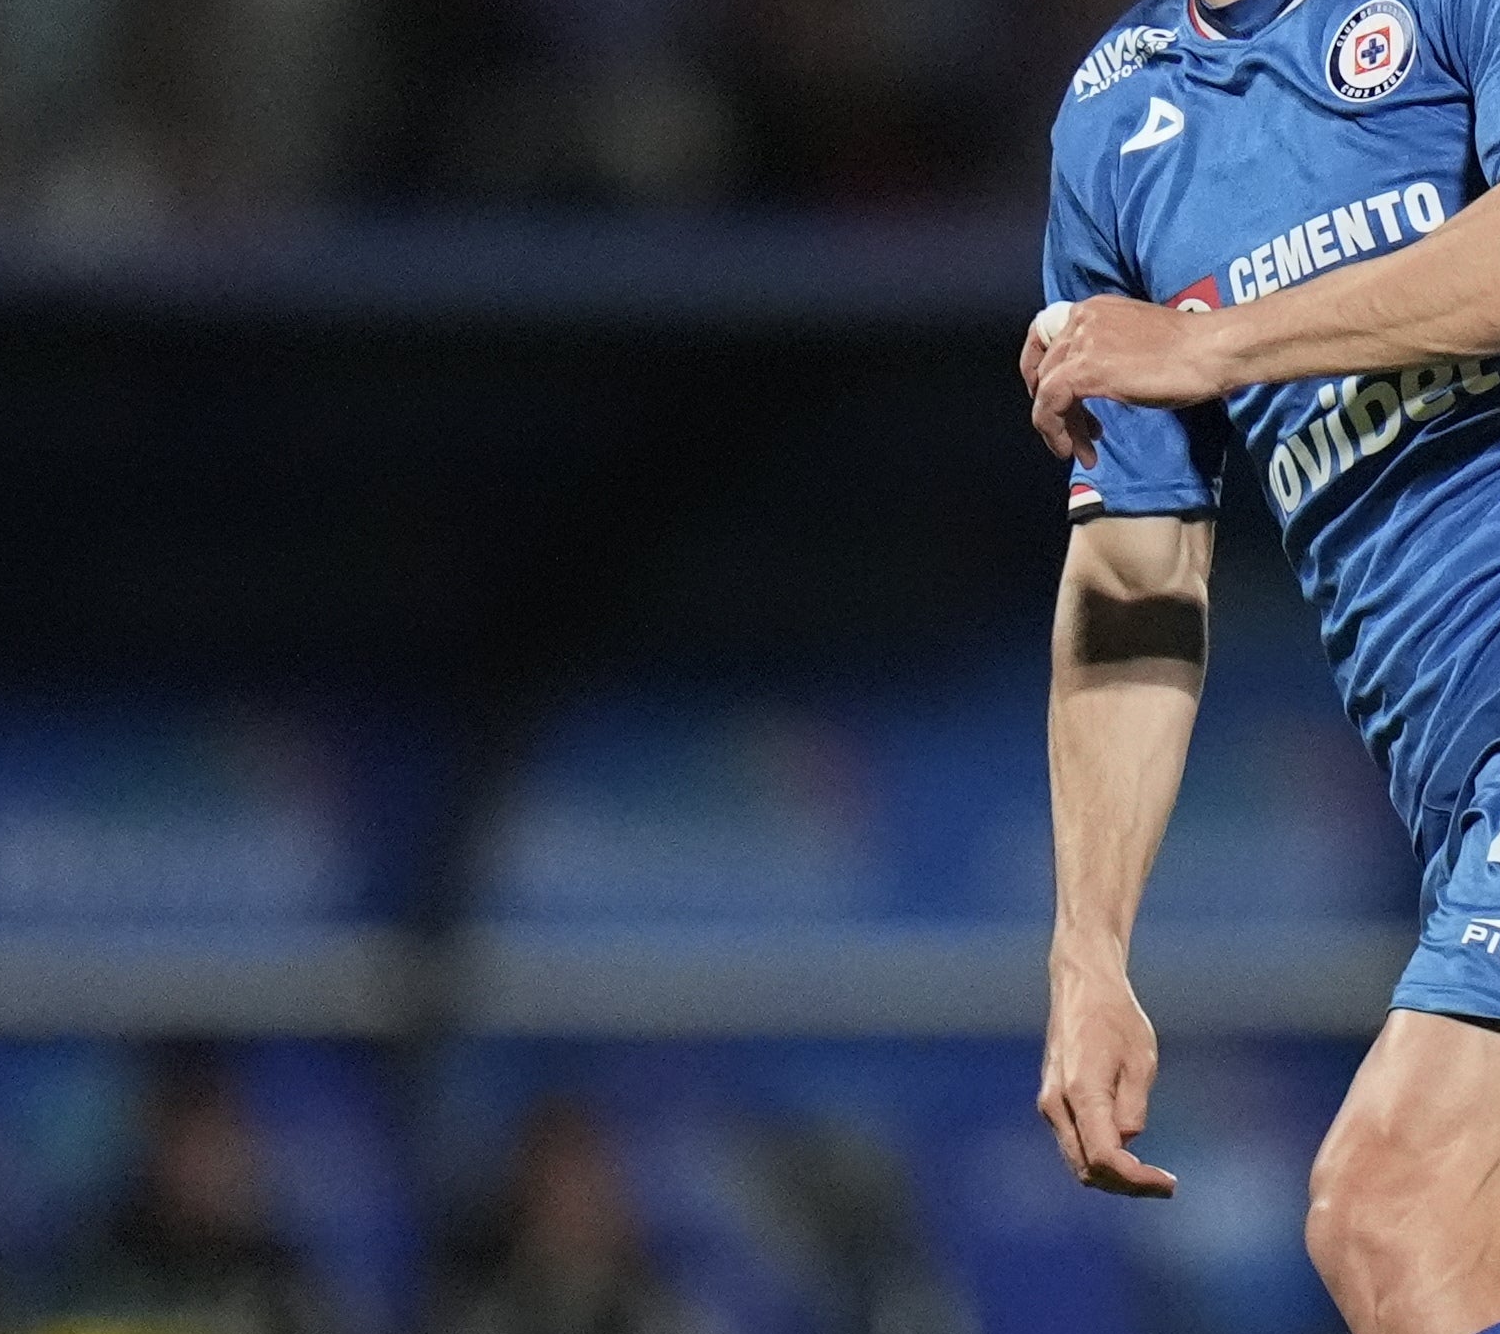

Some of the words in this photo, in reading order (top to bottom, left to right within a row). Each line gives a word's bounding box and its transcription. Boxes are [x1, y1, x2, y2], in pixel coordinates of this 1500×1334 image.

[1336, 19, 1357, 47] CLUB
[1340, 84, 1370, 98] CRUZ
[1374, 69, 1403, 96] AZUL
[1228, 181, 1446, 306] CEMENTO
